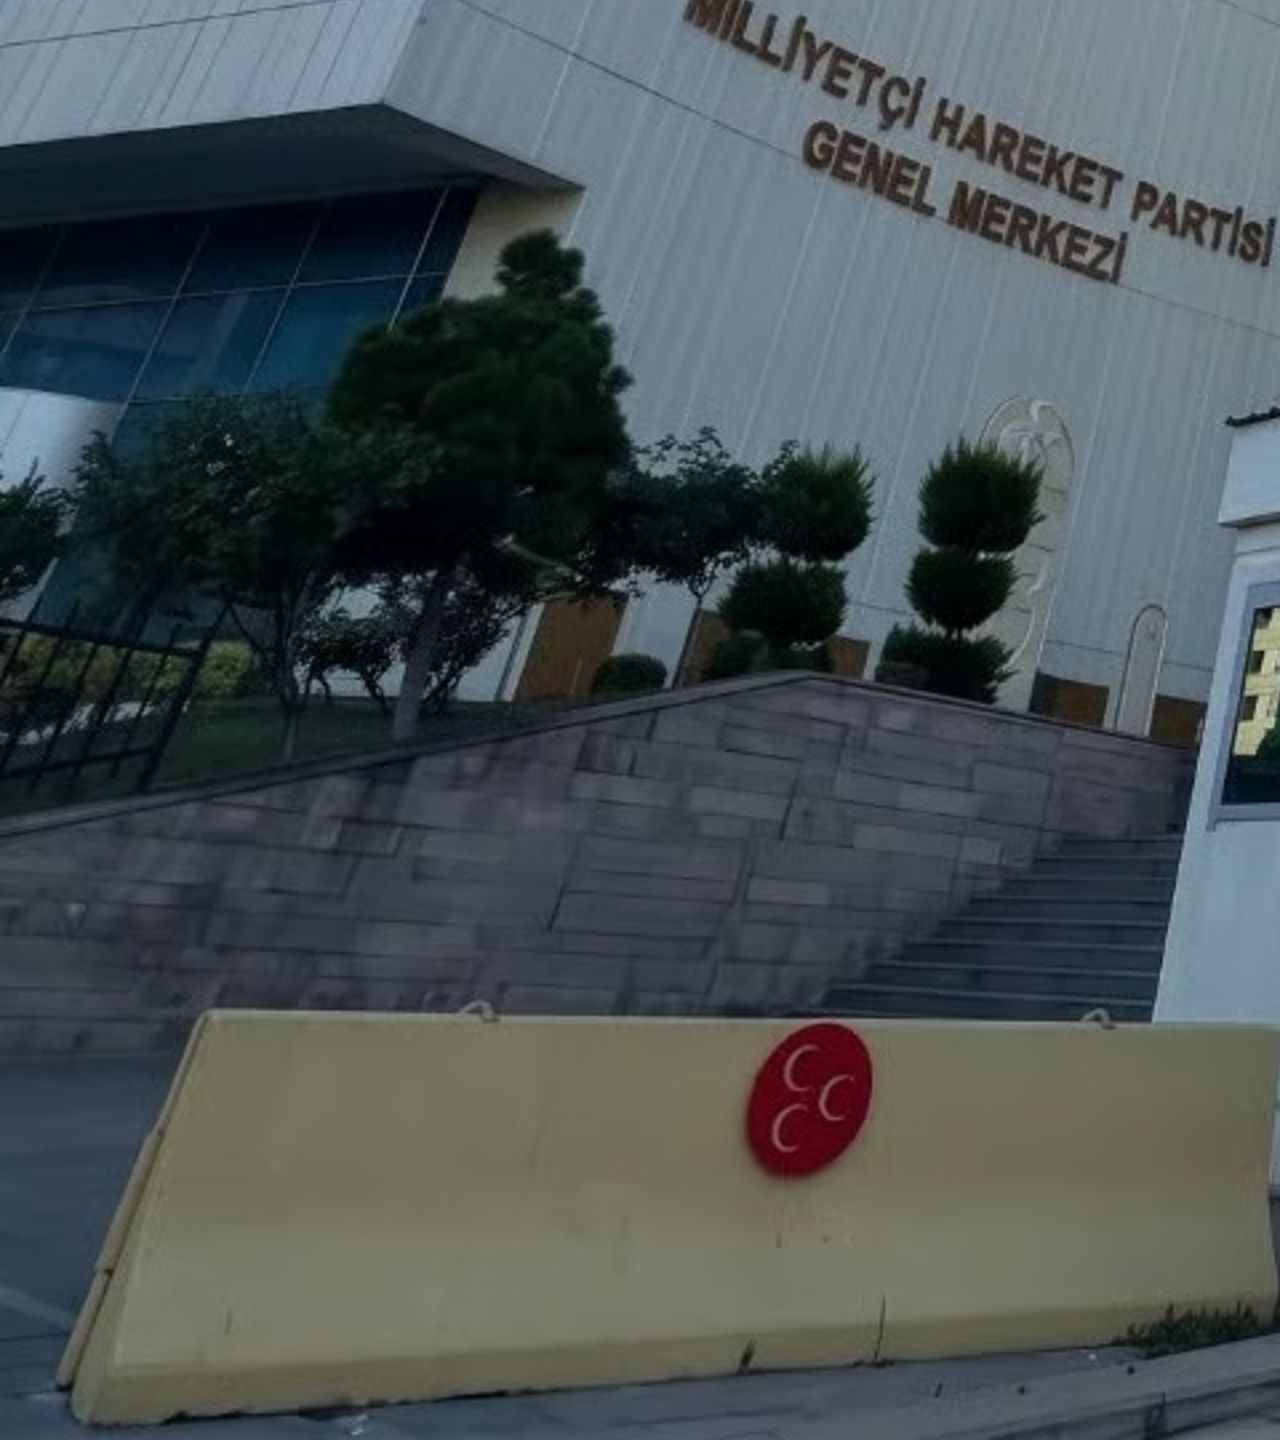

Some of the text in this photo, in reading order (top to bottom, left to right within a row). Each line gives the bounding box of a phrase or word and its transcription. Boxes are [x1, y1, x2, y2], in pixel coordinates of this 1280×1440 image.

[802, 119, 1128, 285] GENEL MERKEZİ
[930, 97, 1123, 210] HAREKET
[1131, 180, 1277, 267] PARTİSİ
